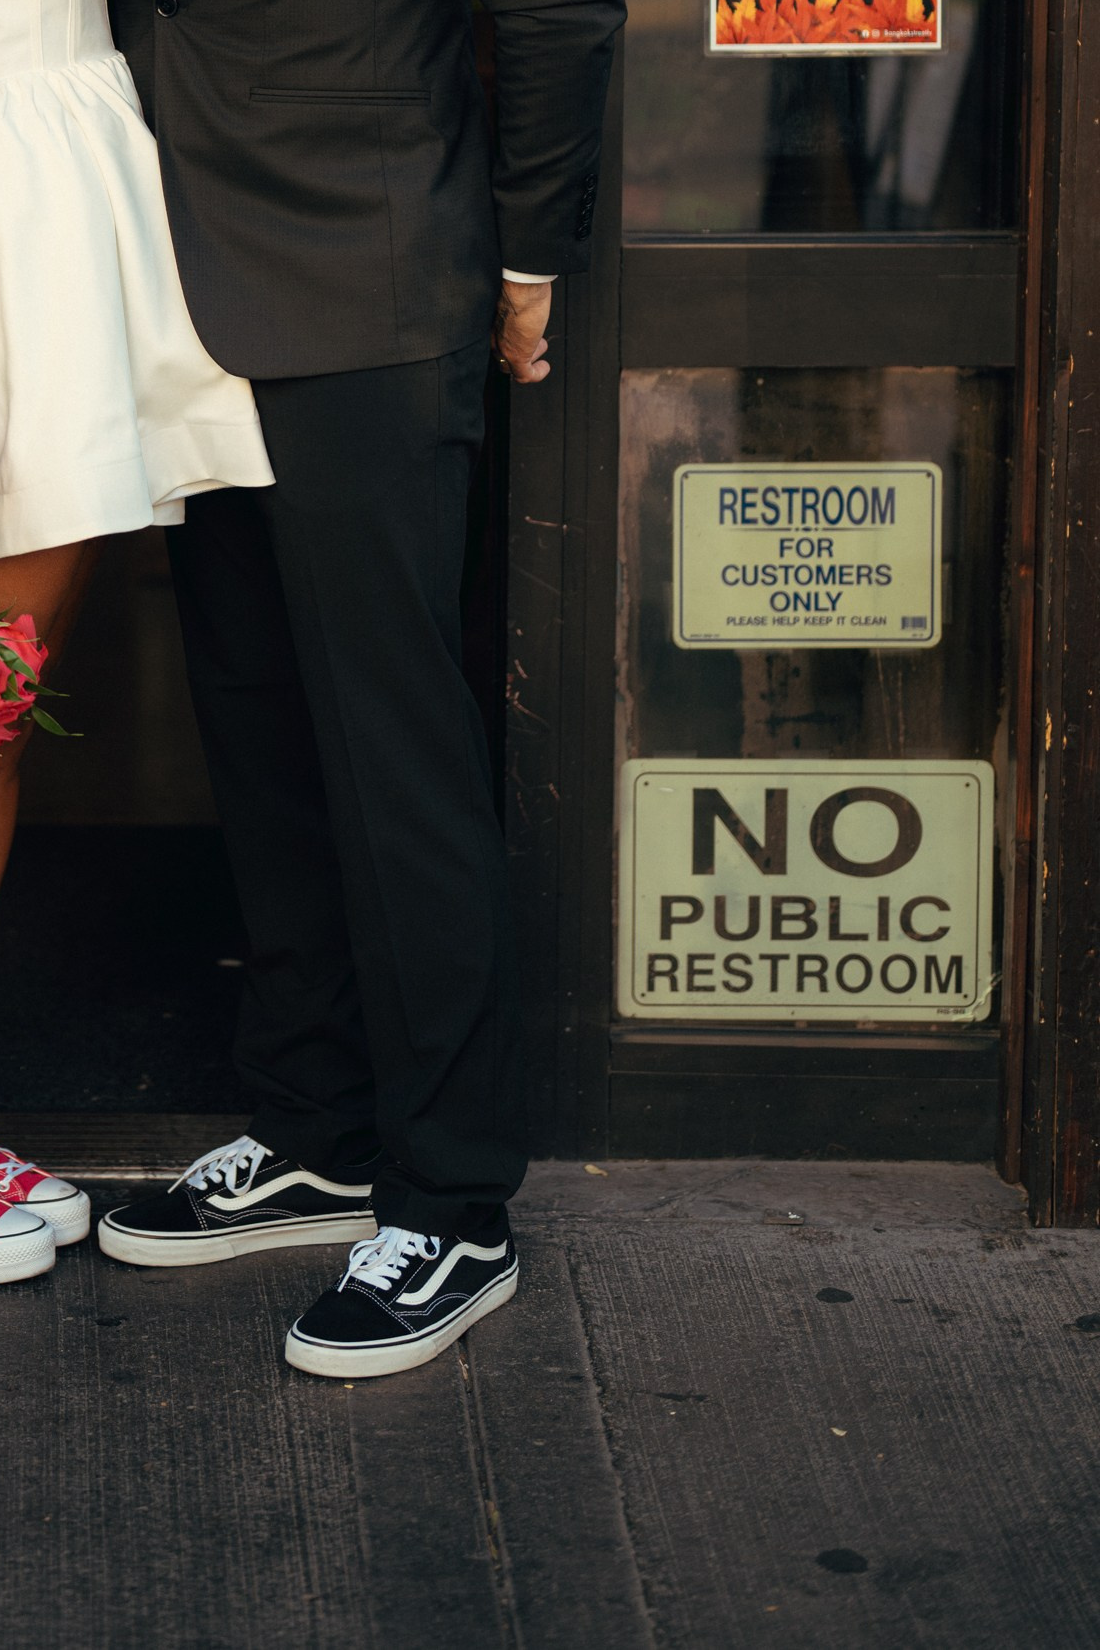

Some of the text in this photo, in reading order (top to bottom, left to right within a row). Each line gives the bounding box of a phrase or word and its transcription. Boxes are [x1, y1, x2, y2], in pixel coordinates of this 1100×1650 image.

[718, 486, 896, 525] RESTROOM
[779, 537, 834, 558] FOR
[721, 564, 892, 586] CUSTOMERS
[769, 591, 843, 612] ONLY
[726, 615, 887, 626] PLEASE HELP KEEP IT CLEAN
[692, 786, 923, 878] NO
[659, 895, 952, 942] PUBLIC
[646, 952, 964, 994] RESTROOM
